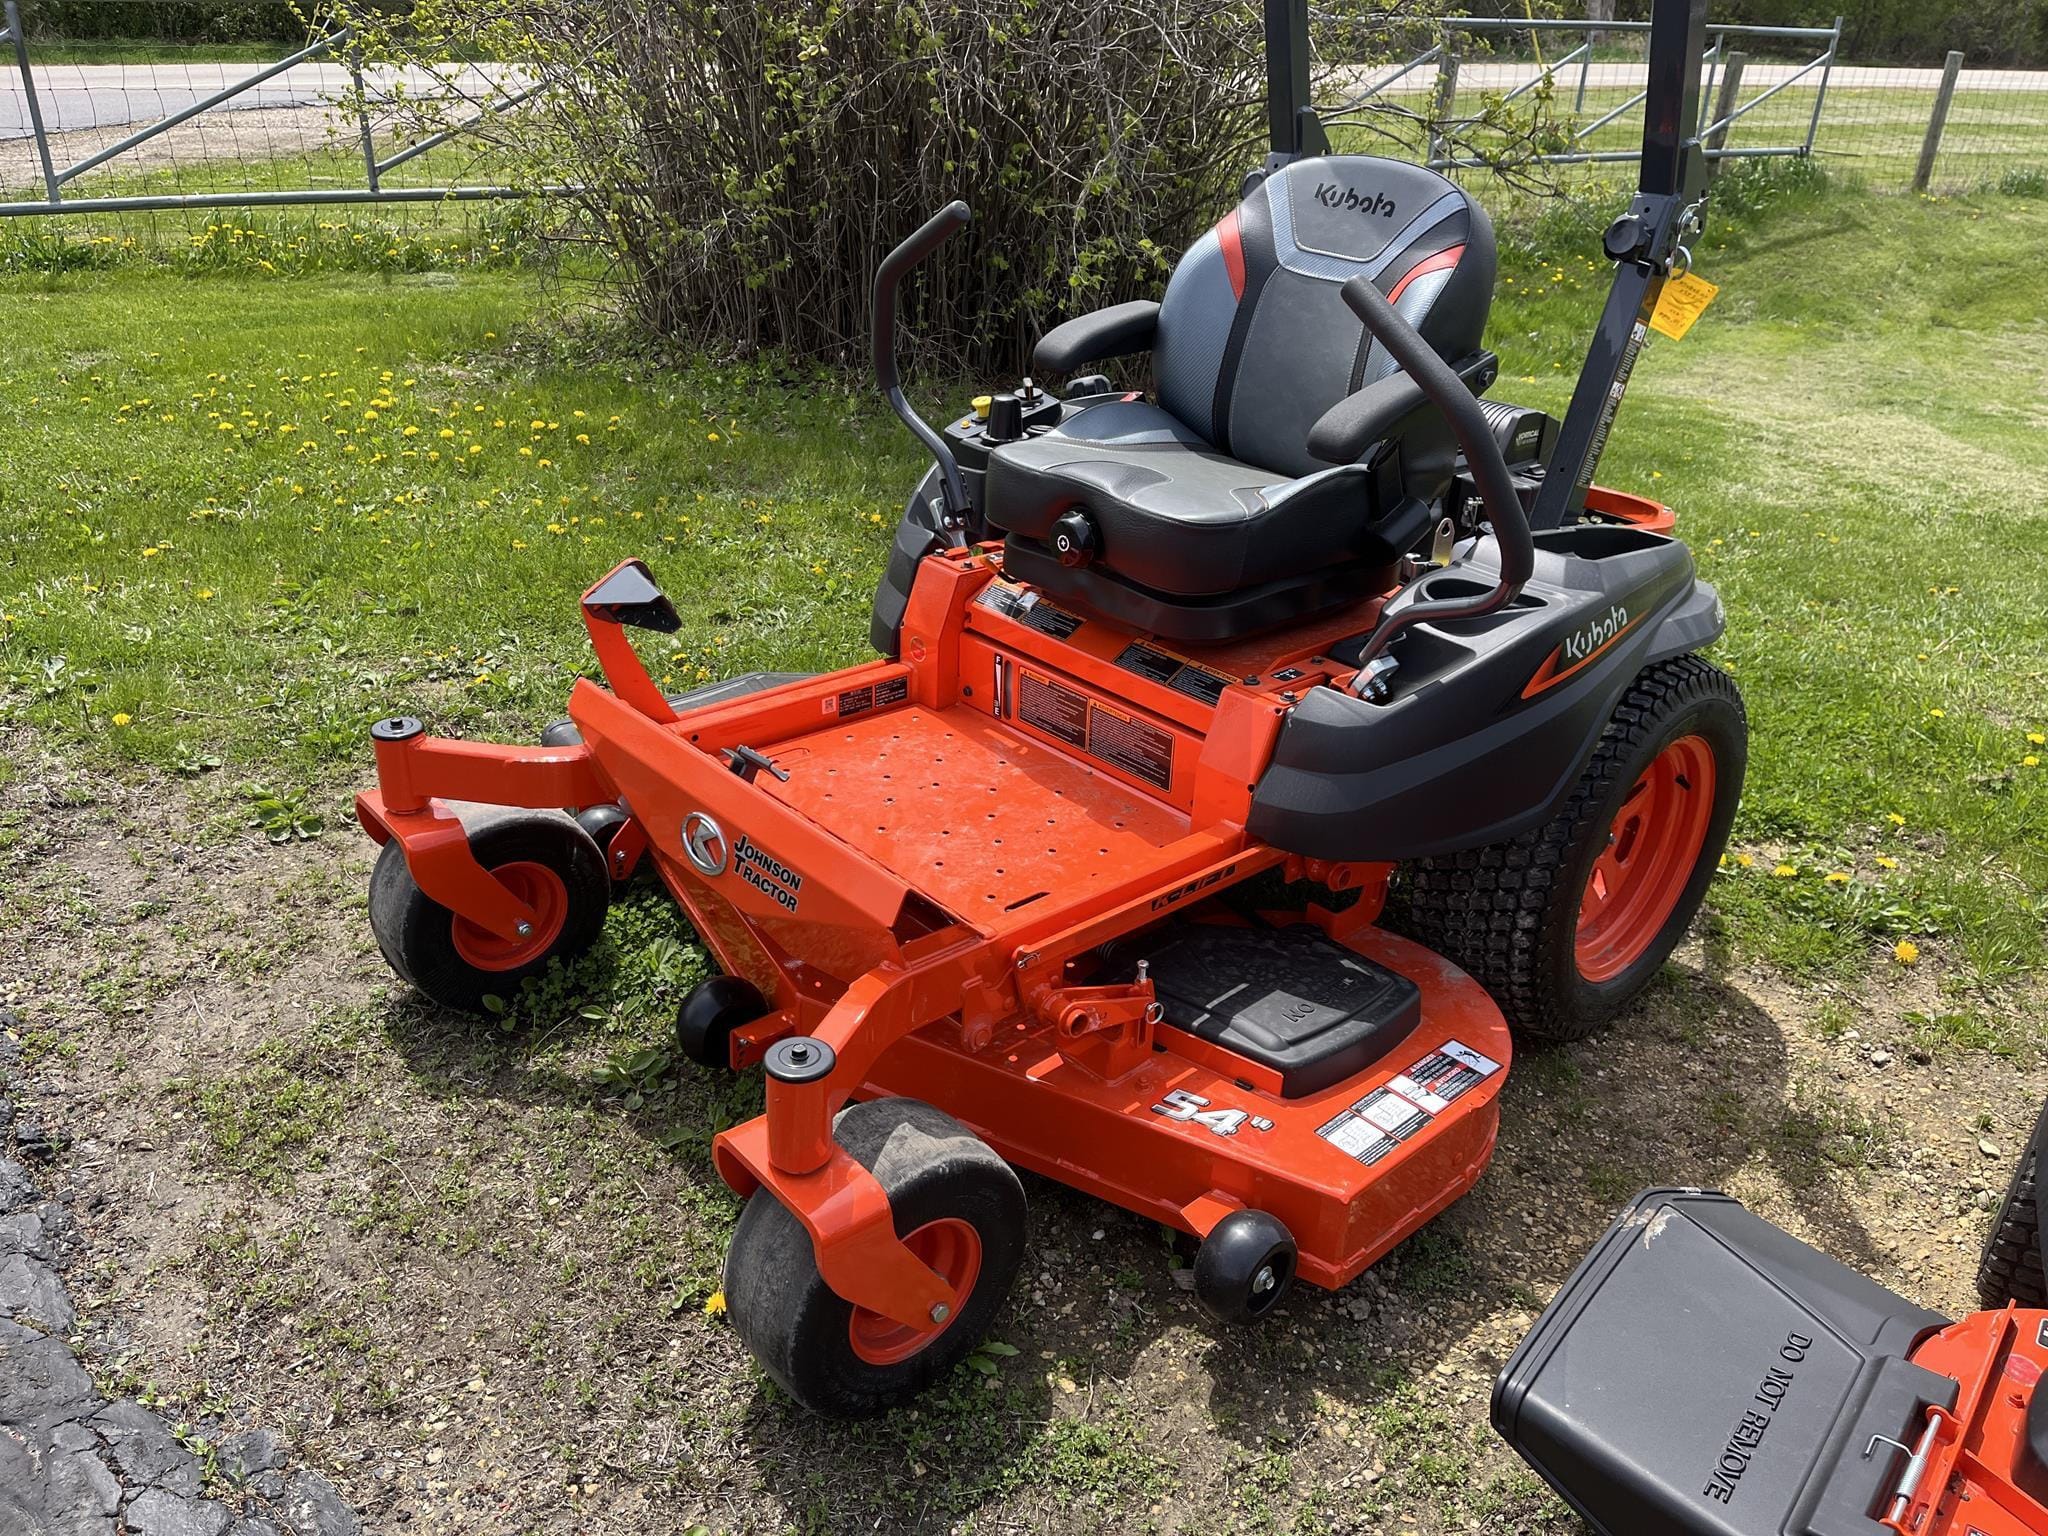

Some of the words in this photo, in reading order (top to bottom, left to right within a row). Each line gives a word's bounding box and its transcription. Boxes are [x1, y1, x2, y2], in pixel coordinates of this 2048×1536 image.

[1314, 182, 1396, 218] Kubota
[1566, 605, 1628, 659] Kubota
[733, 835, 802, 891] JOHNSON
[733, 853, 798, 913] TRACTOR
[1280, 1003, 1316, 1023] NO
[1780, 1330, 1813, 1363] DO
[1755, 1366, 1794, 1412] NOT
[1703, 1407, 1771, 1504] REMOVE
